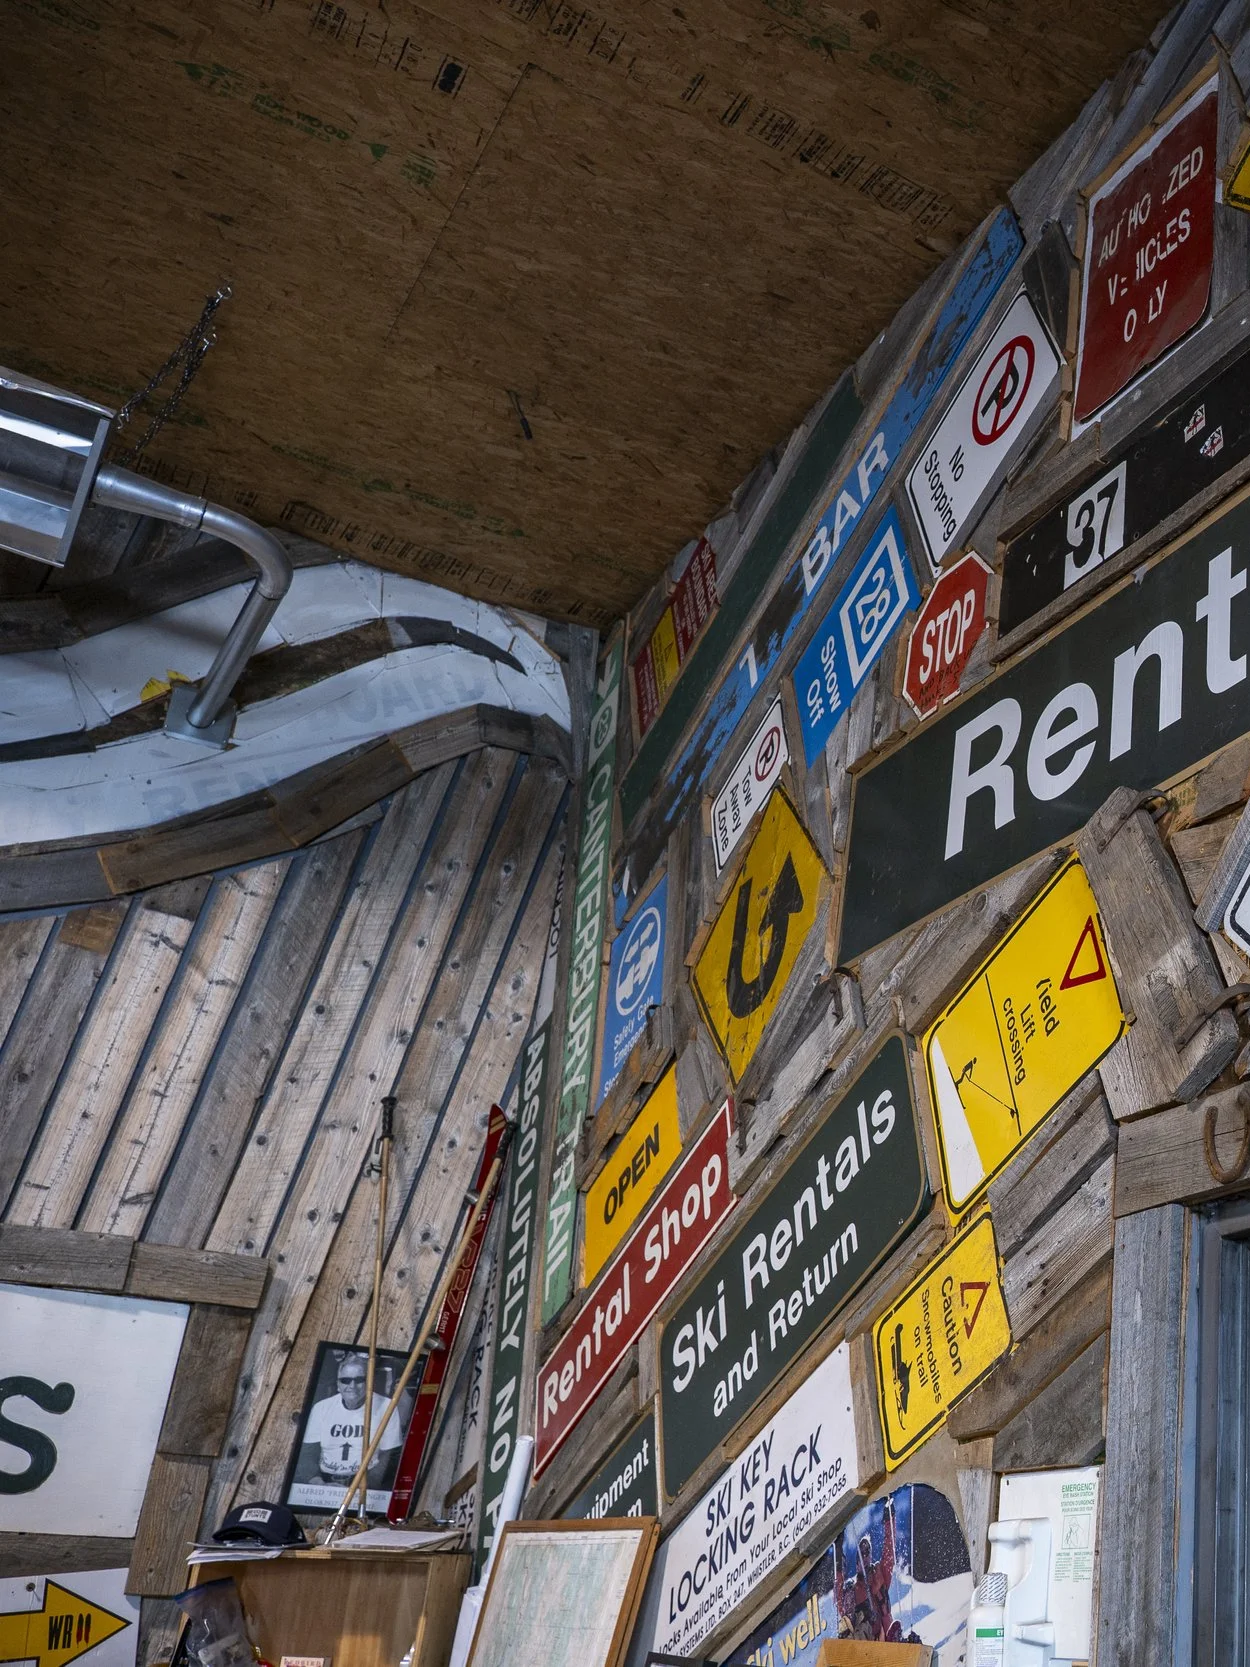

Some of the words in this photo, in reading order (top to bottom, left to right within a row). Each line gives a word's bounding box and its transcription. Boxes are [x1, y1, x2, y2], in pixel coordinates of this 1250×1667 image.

[1124, 280, 1168, 343] OLY
[923, 449, 957, 542] Stopping
[948, 444, 965, 483] No
[801, 431, 889, 597] BAR
[1070, 476, 1122, 571] 37
[820, 635, 842, 713] Show
[918, 588, 976, 685] STOP
[806, 678, 825, 728] Off
[716, 800, 729, 853] Zone
[730, 783, 742, 833] Away
[740, 765, 753, 808] Tow
[561, 763, 612, 1096] CANTERBURY
[613, 1017, 634, 1051] Safety
[1002, 995, 1026, 1087] crossing
[1019, 1003, 1036, 1042] Lift
[500, 1031, 546, 1352] ABSOLUTELY
[544, 1110, 582, 1303] TRAIL
[603, 1126, 661, 1225] OPEN
[672, 1279, 728, 1393] Ski
[742, 1087, 896, 1310] Rentals
[543, 1262, 632, 1428] Rental
[644, 1153, 722, 1284] Shop
[713, 1329, 759, 1418] and
[768, 1222, 858, 1335] Return
[913, 1325, 922, 1345] on
[940, 1275, 964, 1377] Caution
[916, 1351, 928, 1389] trail
[919, 1286, 942, 1405] Snowmobiles
[489, 1376, 516, 1474] NO
[583, 1438, 649, 1519] uipment
[668, 1500, 756, 1624] LOCKING
[763, 1424, 822, 1522] RACK
[705, 1475, 732, 1538] SKI
[740, 1429, 774, 1500] KEY
[1061, 1481, 1097, 1493] EMERGENCY
[679, 1630, 704, 1657] SYSTEMS
[718, 1602, 732, 1622] BOX
[792, 1512, 812, 1543] (604)
[814, 1474, 847, 1516] 932-7055
[683, 1583, 724, 1636] Available
[726, 1562, 747, 1588] From
[750, 1536, 770, 1565] Your
[772, 1506, 798, 1541] Local
[800, 1487, 814, 1511] Ski
[817, 1457, 842, 1493] Shop
[779, 1594, 829, 1658] well.
